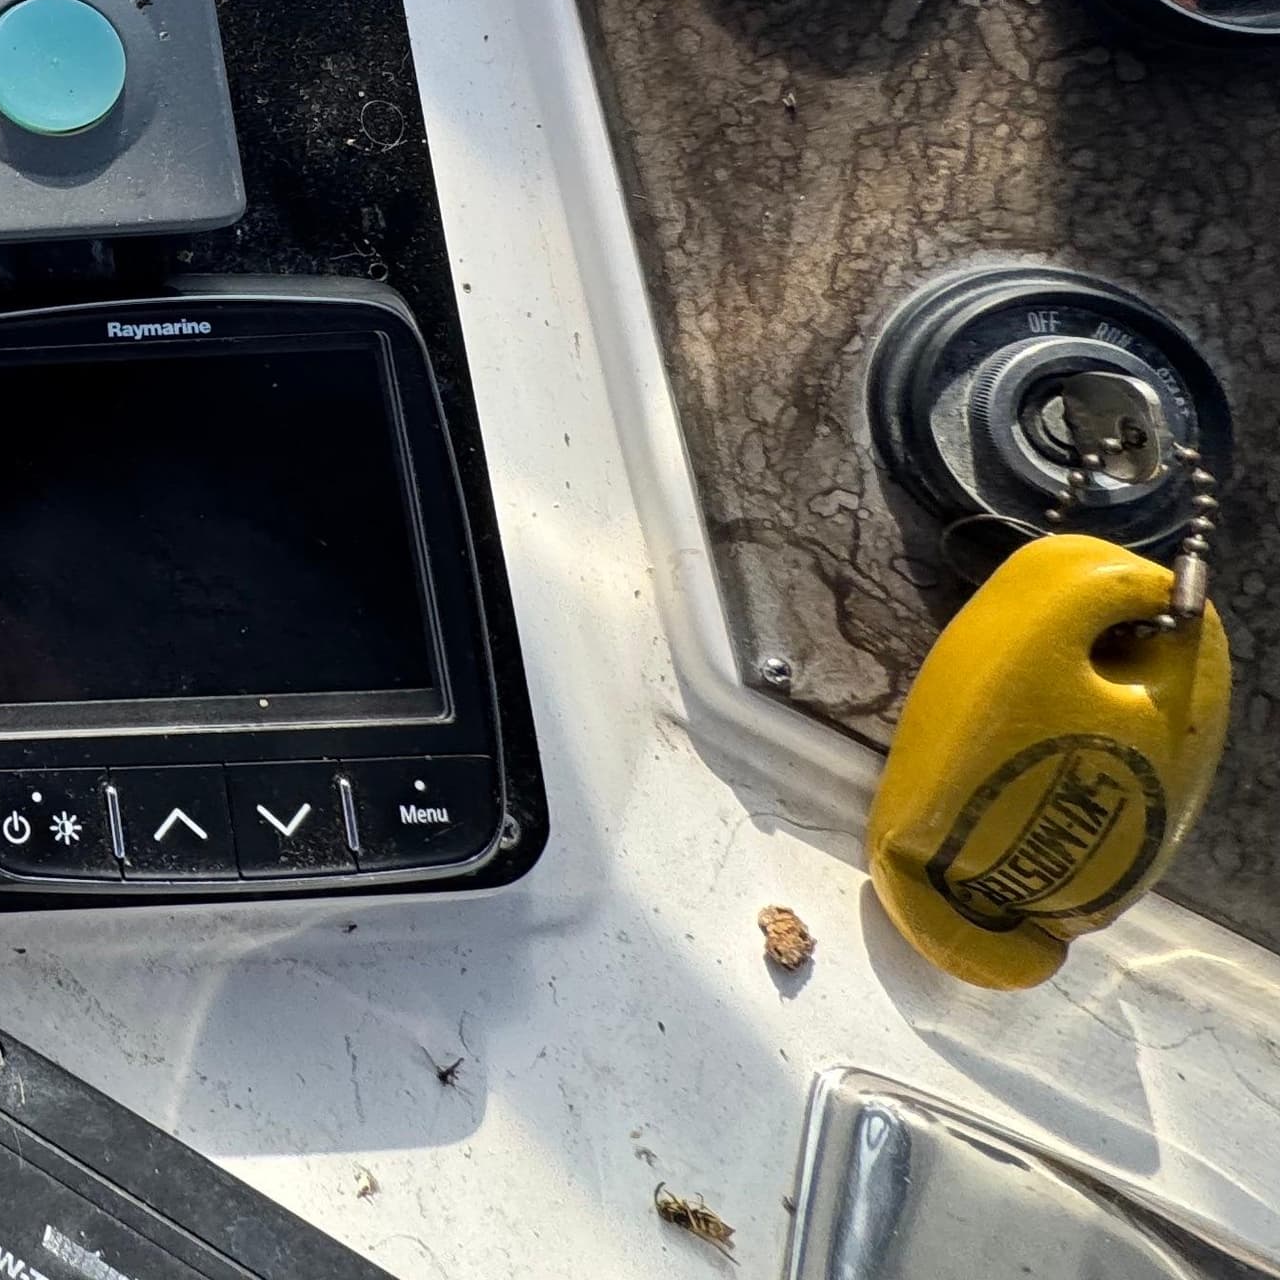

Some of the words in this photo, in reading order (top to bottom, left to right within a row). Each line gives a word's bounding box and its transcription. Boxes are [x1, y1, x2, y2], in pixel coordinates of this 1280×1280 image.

[107, 318, 212, 340] Raymarine
[1027, 310, 1061, 334] OFF
[400, 803, 448, 824] Menu
